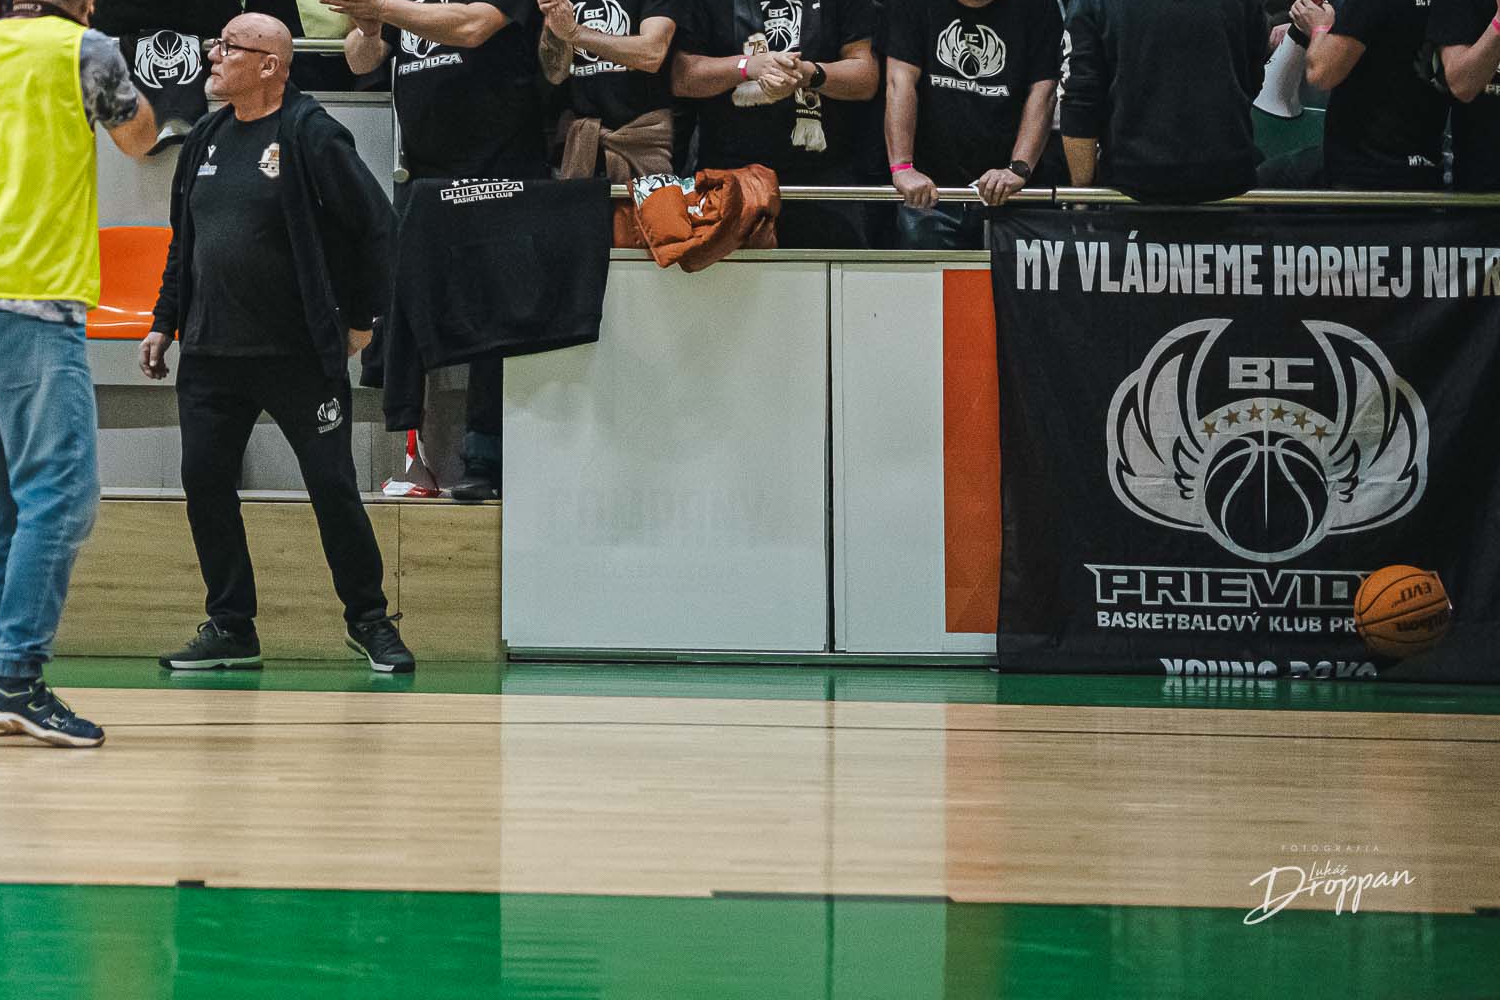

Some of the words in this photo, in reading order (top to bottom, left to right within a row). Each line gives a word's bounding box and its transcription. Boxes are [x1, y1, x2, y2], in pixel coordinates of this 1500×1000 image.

[583, 7, 604, 20] BC
[768, 6, 789, 18] BC
[441, 182, 523, 200] PRIEVIDZA
[453, 193, 496, 205] BASKETBALL
[1016, 239, 1064, 290] MY
[1075, 231, 1263, 295] VLÁDNEME
[1273, 245, 1412, 298] HORNEJ
[1228, 356, 1314, 391] BC
[1083, 564, 1364, 609] PRIEVID
[1097, 611, 1261, 633] BASKETBALOVÝ
[1269, 616, 1322, 633] KLUB
